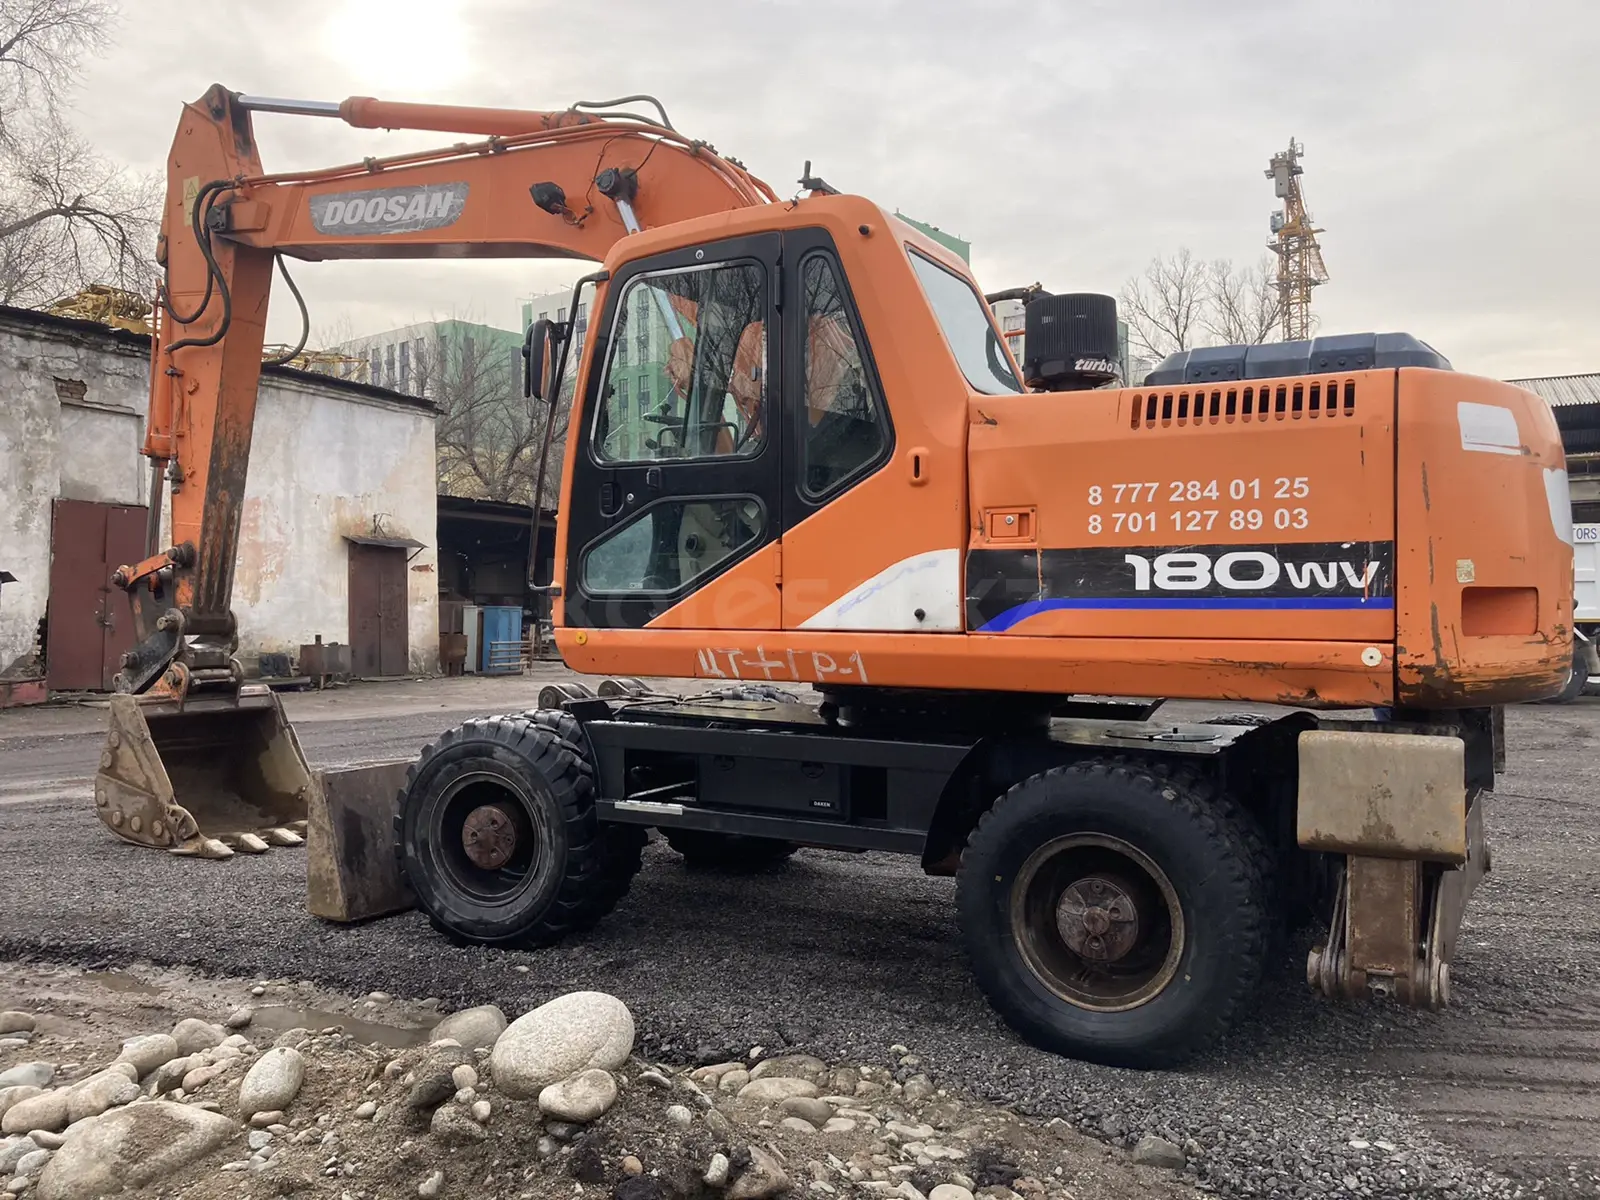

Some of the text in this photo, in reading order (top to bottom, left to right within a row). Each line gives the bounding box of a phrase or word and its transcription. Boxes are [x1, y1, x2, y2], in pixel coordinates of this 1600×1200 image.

[322, 191, 454, 226] DOOSAN
[1074, 358, 1113, 373] turbo
[1088, 476, 1310, 506] 8 777 284 01 25
[1088, 507, 1309, 535] 8 701 127 89 03
[1573, 527, 1598, 540] ORS
